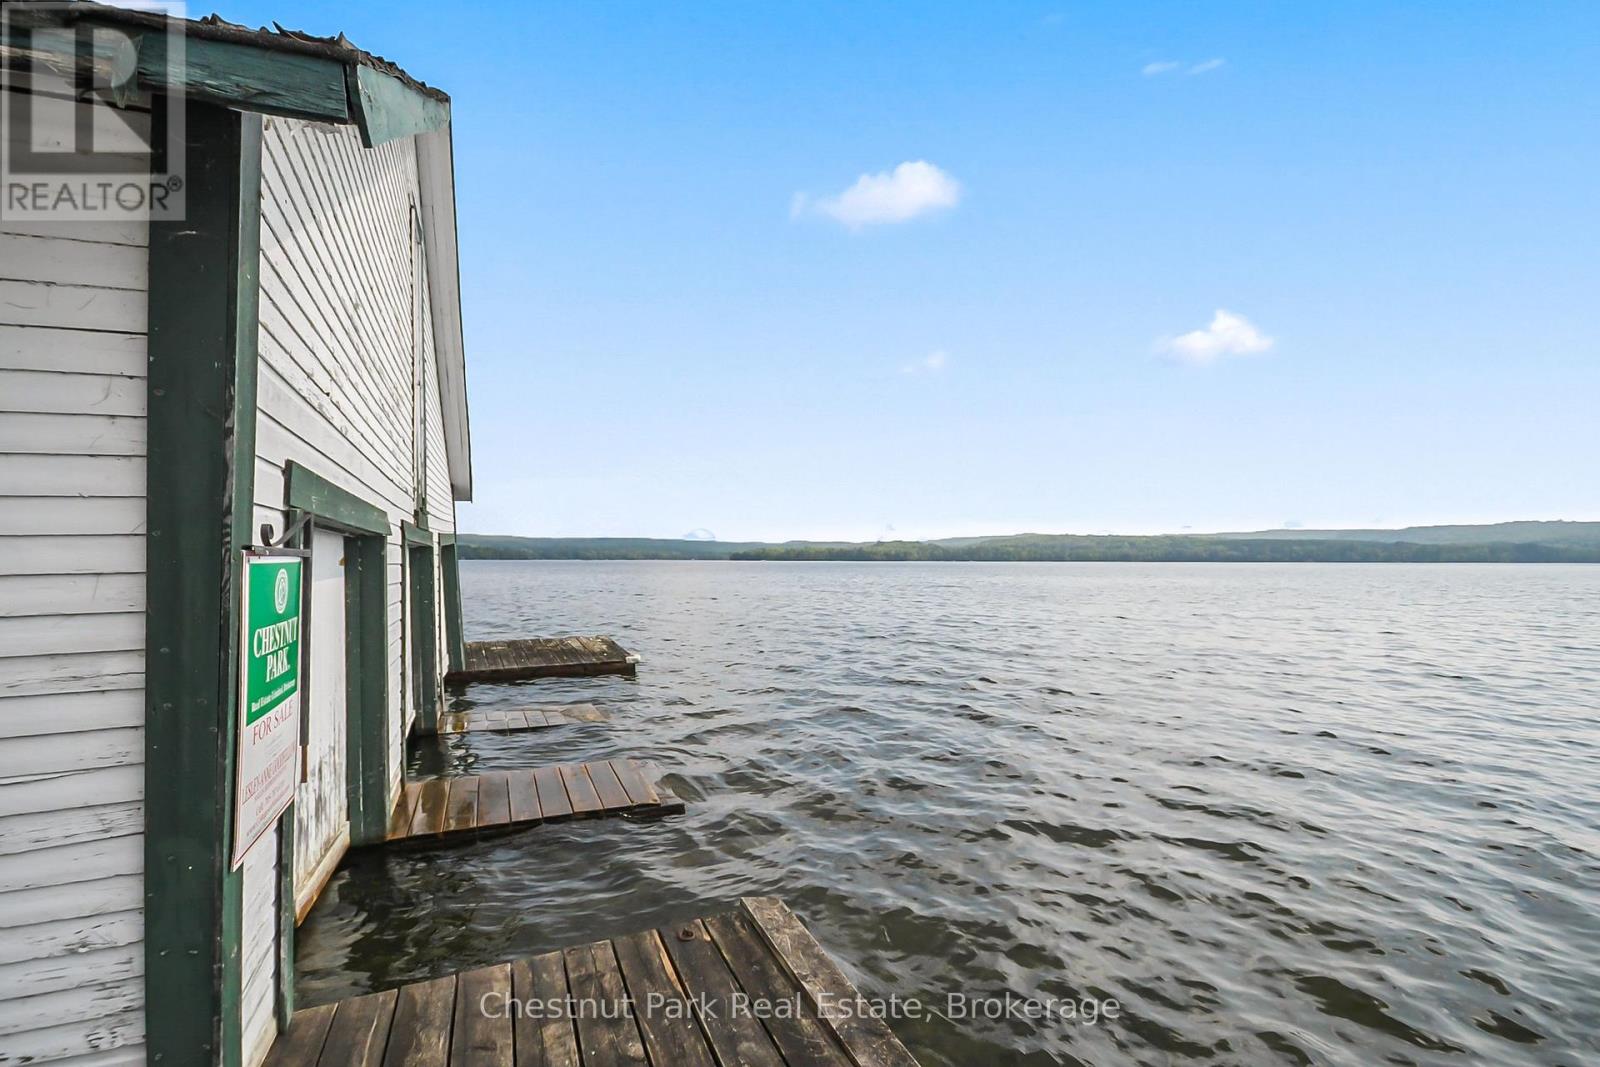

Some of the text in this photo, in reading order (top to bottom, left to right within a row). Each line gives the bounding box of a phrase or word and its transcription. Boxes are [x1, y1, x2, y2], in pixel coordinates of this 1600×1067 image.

[253, 616, 298, 658] CHESTNUT
[265, 646, 289, 683] PARK
[252, 700, 294, 746] FOR SALE
